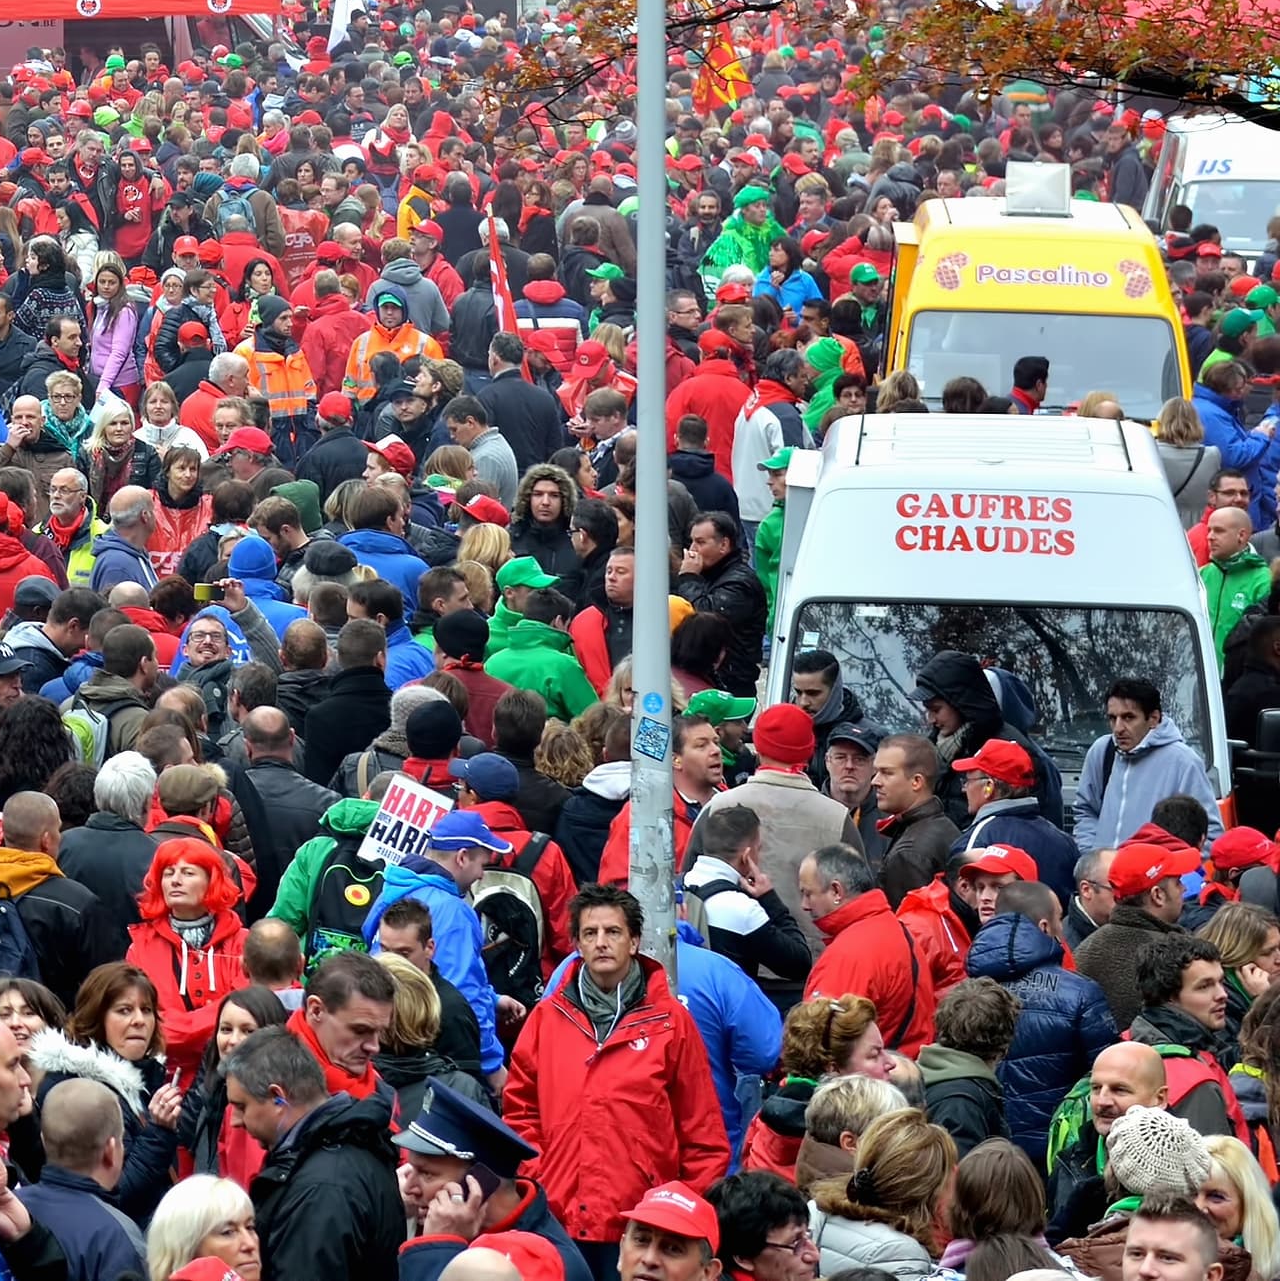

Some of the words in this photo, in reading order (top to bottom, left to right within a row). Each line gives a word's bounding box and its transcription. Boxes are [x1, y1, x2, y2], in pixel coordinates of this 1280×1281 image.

[1195, 159, 1233, 176] IJS
[976, 265, 1110, 287] Pascalino
[896, 493, 1072, 523] GAUFRES
[895, 525, 1076, 556] CHAUDES
[382, 784, 448, 829] HART
